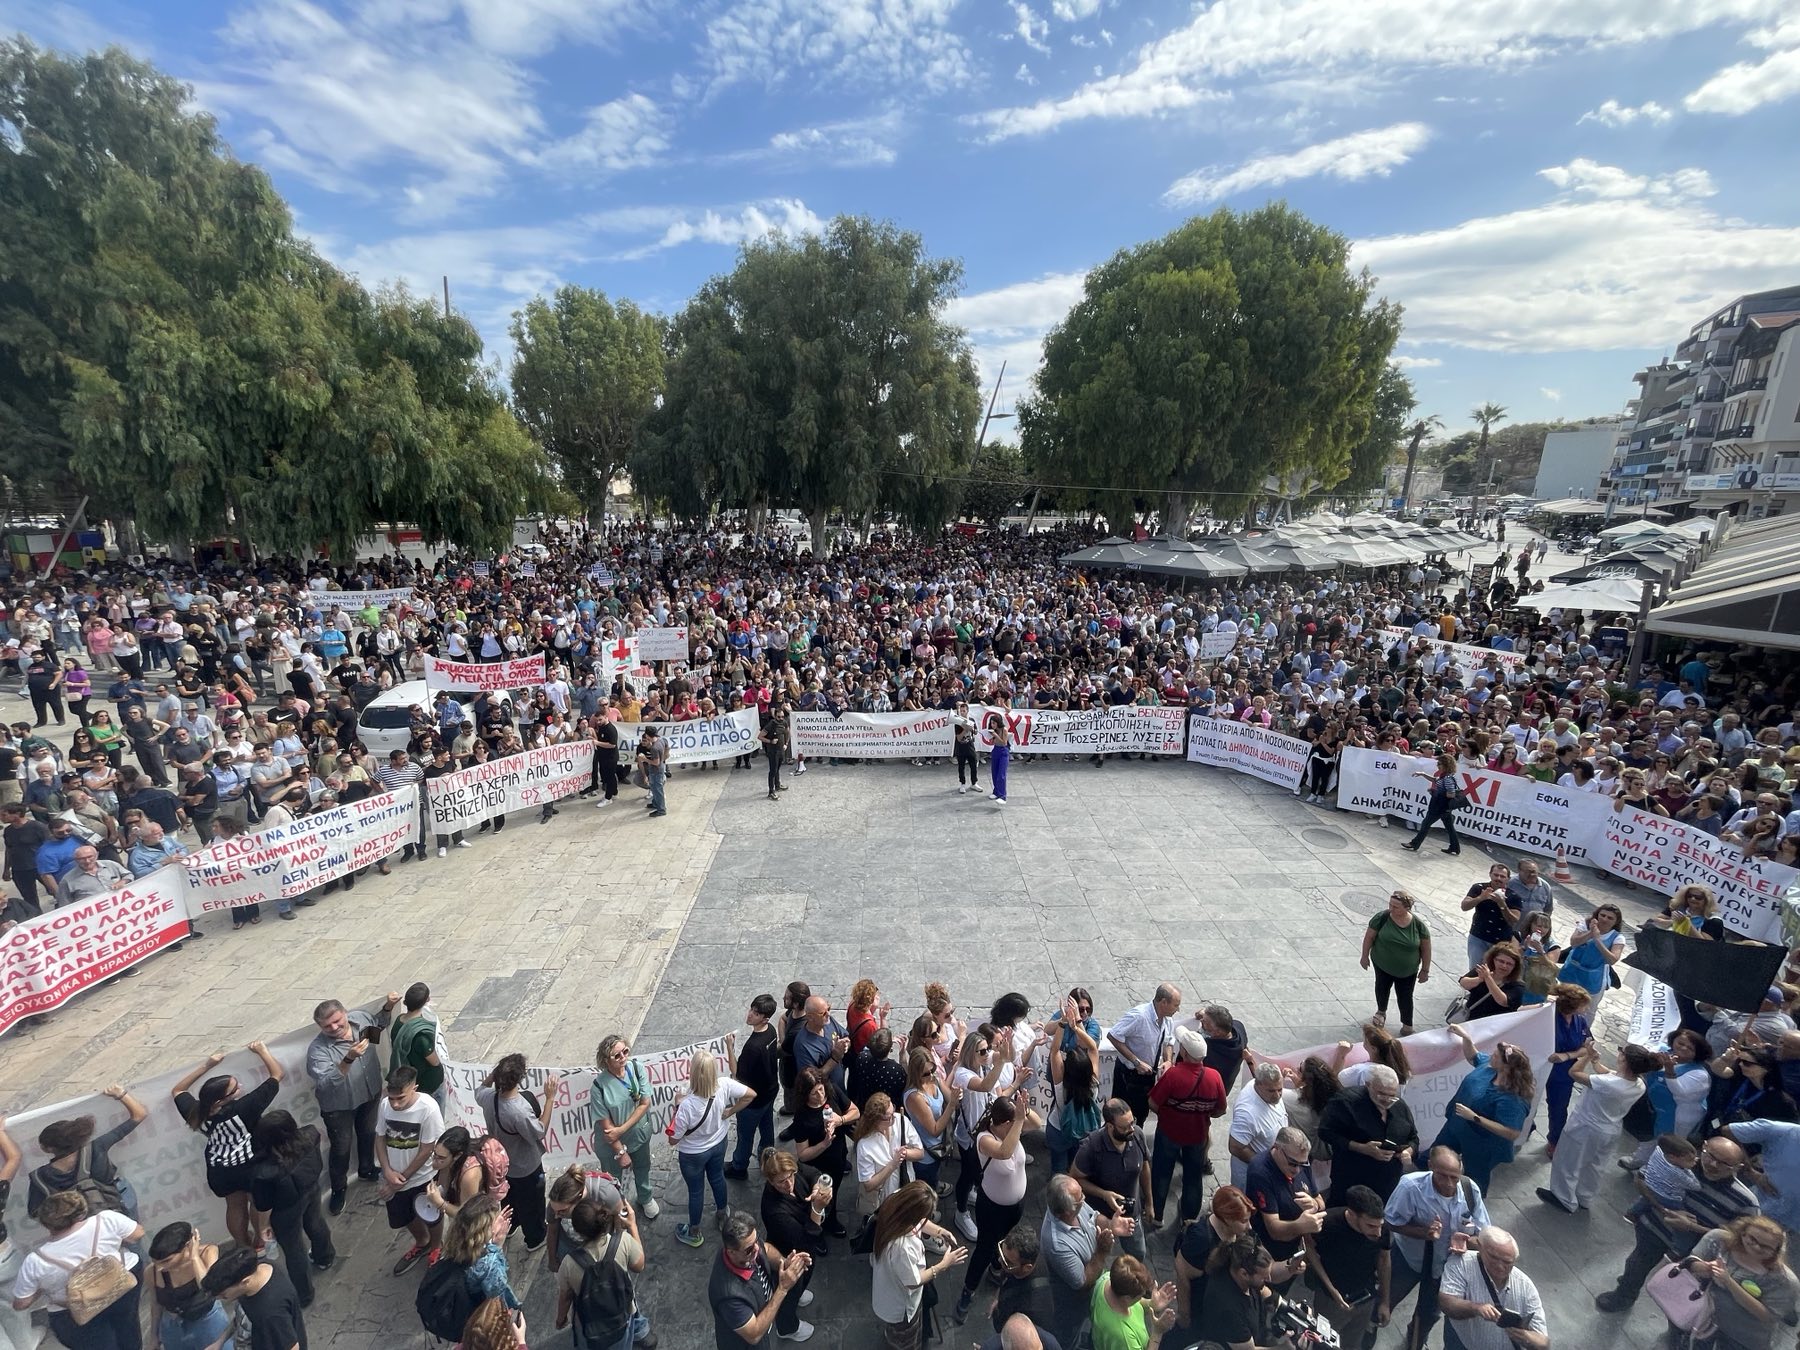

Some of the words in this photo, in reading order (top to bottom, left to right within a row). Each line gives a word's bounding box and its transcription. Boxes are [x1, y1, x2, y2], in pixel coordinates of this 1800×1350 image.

[448, 671, 485, 684] ΥΓΕΙΑ
[485, 672, 504, 683] ΓΙΑ
[509, 668, 540, 679] ΟΛΟΥΣ
[619, 734, 697, 755] ΔΗΣΙΟ
[700, 728, 752, 751] ΑΓΑΘΟ
[699, 715, 737, 736] ΕΙΝΑΙ
[796, 717, 843, 726] ΑΠΟΚΛΕΙΣΤΙΚΑ
[891, 727, 910, 739] ΓΙΑ
[914, 716, 949, 734] ΟΛΟΥΣ
[982, 711, 1032, 746] ΟΧΙ
[1030, 733, 1058, 746] ΣΤΙΣ
[1032, 723, 1060, 734] ΣΤΗΝ
[1164, 720, 1182, 731] ΕΣΥ
[1193, 718, 1209, 731] ΚΑΤΩ
[1211, 720, 1218, 732] ΤΑ
[1219, 723, 1239, 736] ΧΕΡΙΑ
[1240, 727, 1255, 740] ΑΠΟ
[1255, 731, 1264, 743] ΤΑ
[1264, 733, 1309, 758] ΝΟΣΟΚΟΜΕΙΑ
[428, 782, 439, 794] Η
[442, 771, 474, 793] ΥΓΕΙΑ
[476, 765, 497, 784] ΔΕΝ
[499, 758, 525, 778] ΕΙΝΑΙ
[529, 743, 592, 768] ΕΜΠΟΡΕΥΜΑ
[1190, 734, 1217, 752] ΑΓΩΝΑΣ
[1217, 739, 1228, 753] ΓΙΑ
[1228, 742, 1259, 761] ΔΗΜΟΣΙΑ
[1259, 750, 1287, 770] ΔΩΡΕΑΝ
[430, 788, 467, 809] ΚΑΤΩ
[469, 782, 486, 797] ΤΑ
[487, 773, 520, 793] ΧΕΡΙΑ
[526, 765, 550, 783] ΑΠΟ
[557, 759, 574, 775] ΤΟ
[1462, 772, 1502, 808] ΧΙ
[1535, 791, 1570, 808] ΕΦΚΑ
[266, 829, 285, 843] ΝΑ
[354, 793, 395, 814] ΤΕΛΟΣ
[435, 789, 506, 823] ΒΕΝΙΖΕΛΕΙΟ
[1382, 785, 1411, 805] ΣΤΗΝ
[1537, 821, 1569, 839] ΤΗΣ
[187, 864, 222, 879] ΣΤΗΝ
[227, 834, 318, 873] ΕΓΚΛΗΜΑΤΙΚΗ
[320, 823, 356, 842] ΤΟΥΣ
[358, 801, 414, 829] ΠΟΛΙΤΙΚΗ
[1633, 813, 1687, 837] ΚΑΤΩ
[1693, 833, 1712, 850] ΤΑ
[190, 878, 201, 890] Η
[202, 872, 247, 890] ΥΓΕΙΑ
[251, 861, 281, 877] ΤΟΥ
[289, 845, 329, 867] ΛΑΟΥ
[281, 869, 310, 886] ΔΕΝ
[318, 853, 349, 872] ΕΙΝΑΙ
[354, 824, 412, 858] ΚΟΣΤΟΣ!
[1606, 830, 1662, 860] ΚΑΜΙΑ
[1671, 855, 1782, 916] ΣΥΓΧΩΝΕΥΣΗ
[1607, 815, 1635, 838] ΑΠΟ
[1644, 831, 1668, 850] ΤΟ
[1676, 841, 1782, 897] ΒΕΝΙΖΕΛΕΙ
[1611, 858, 1671, 887] ΕΛΜΕ
[203, 892, 267, 911] ΕΡΓΑΤΙΚΑ
[281, 870, 337, 898] ΣΩΜΑΤΕΙΑ
[347, 843, 396, 872] ΗΡΑΚΛΕΙΟΥ
[1614, 849, 1753, 918] ΝΟΣΟΚΟΙΩΝ
[70, 924, 88, 939] Ο
[100, 891, 161, 927] ΛΑΟΣ
[44, 921, 160, 986] ΚΑΝΕΝΟΣ
[61, 978, 81, 995] ΙΚΑ
[83, 968, 97, 982] Ν.
[100, 935, 162, 976] ΗΡΑΚΛΕΙΟΥ
[1651, 979, 1666, 1030] ΑΖΟΜΕΝΩΝ
